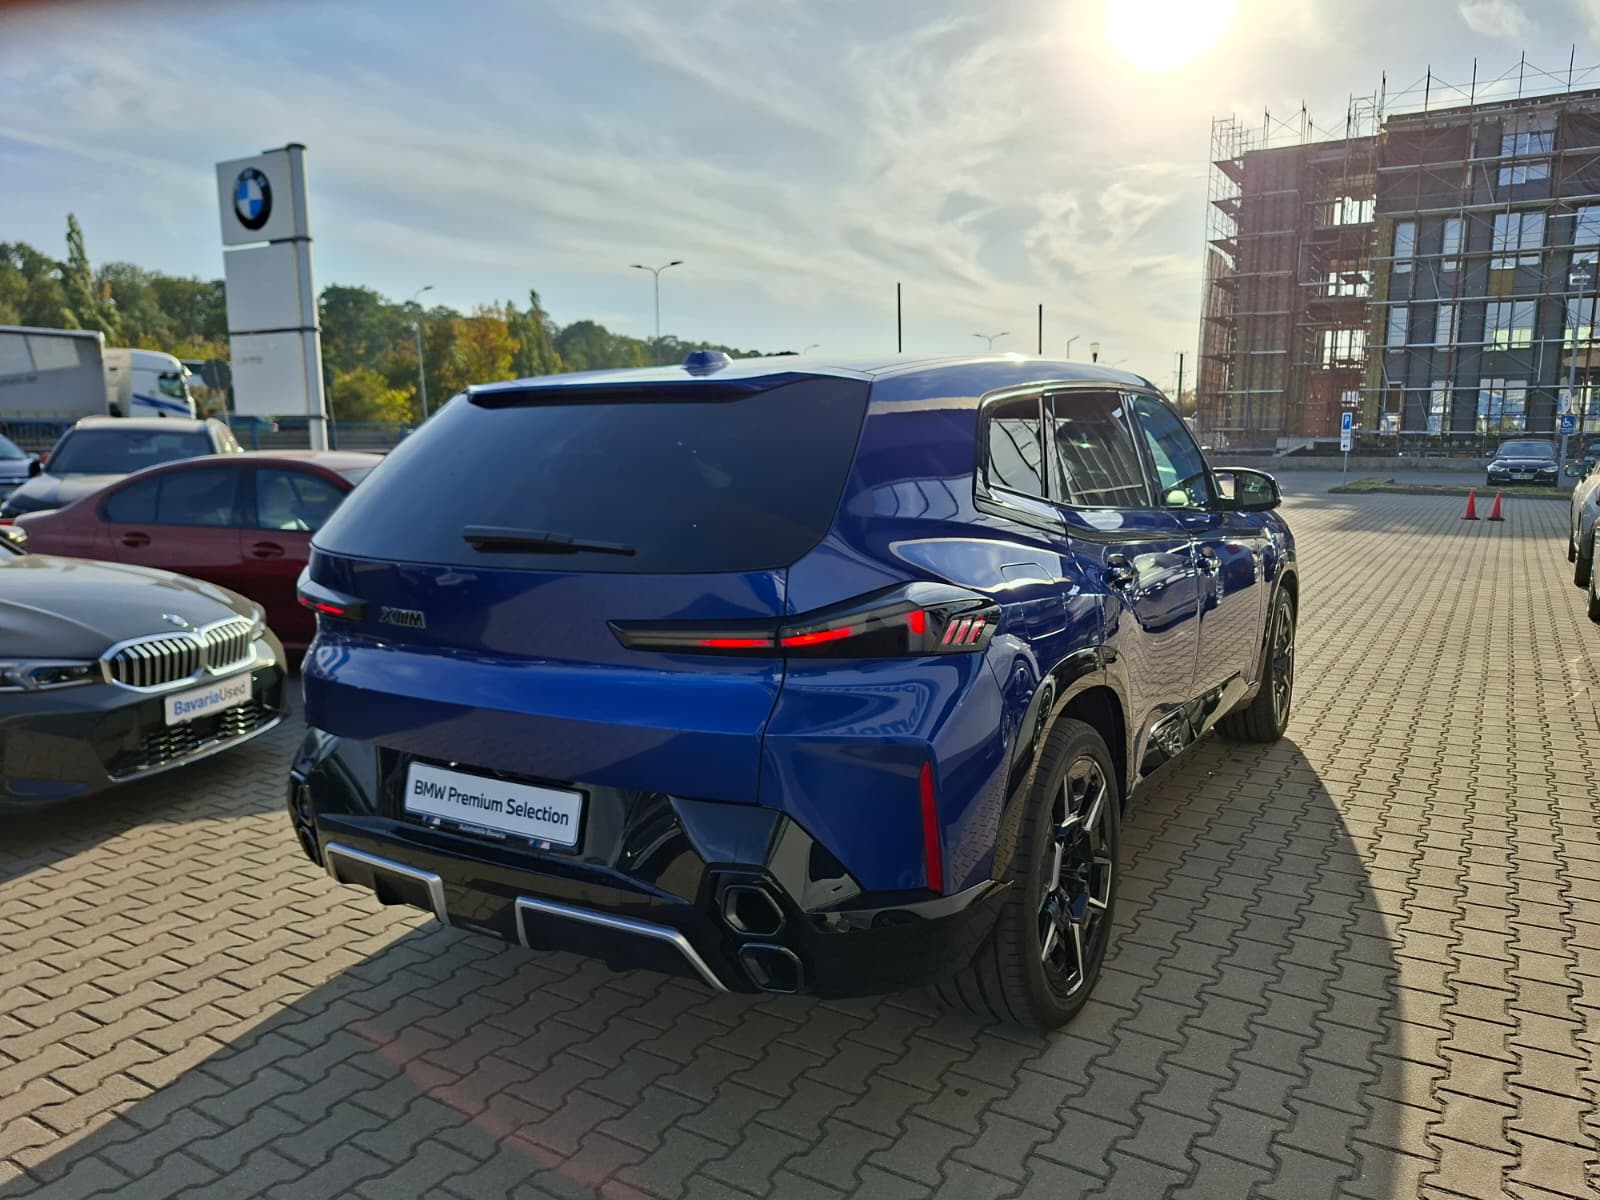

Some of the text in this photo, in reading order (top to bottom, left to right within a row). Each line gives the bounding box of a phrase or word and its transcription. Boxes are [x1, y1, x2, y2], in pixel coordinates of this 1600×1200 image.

[174, 680, 246, 716] BavariaUsed
[414, 779, 569, 826] BMW Premium Selection
